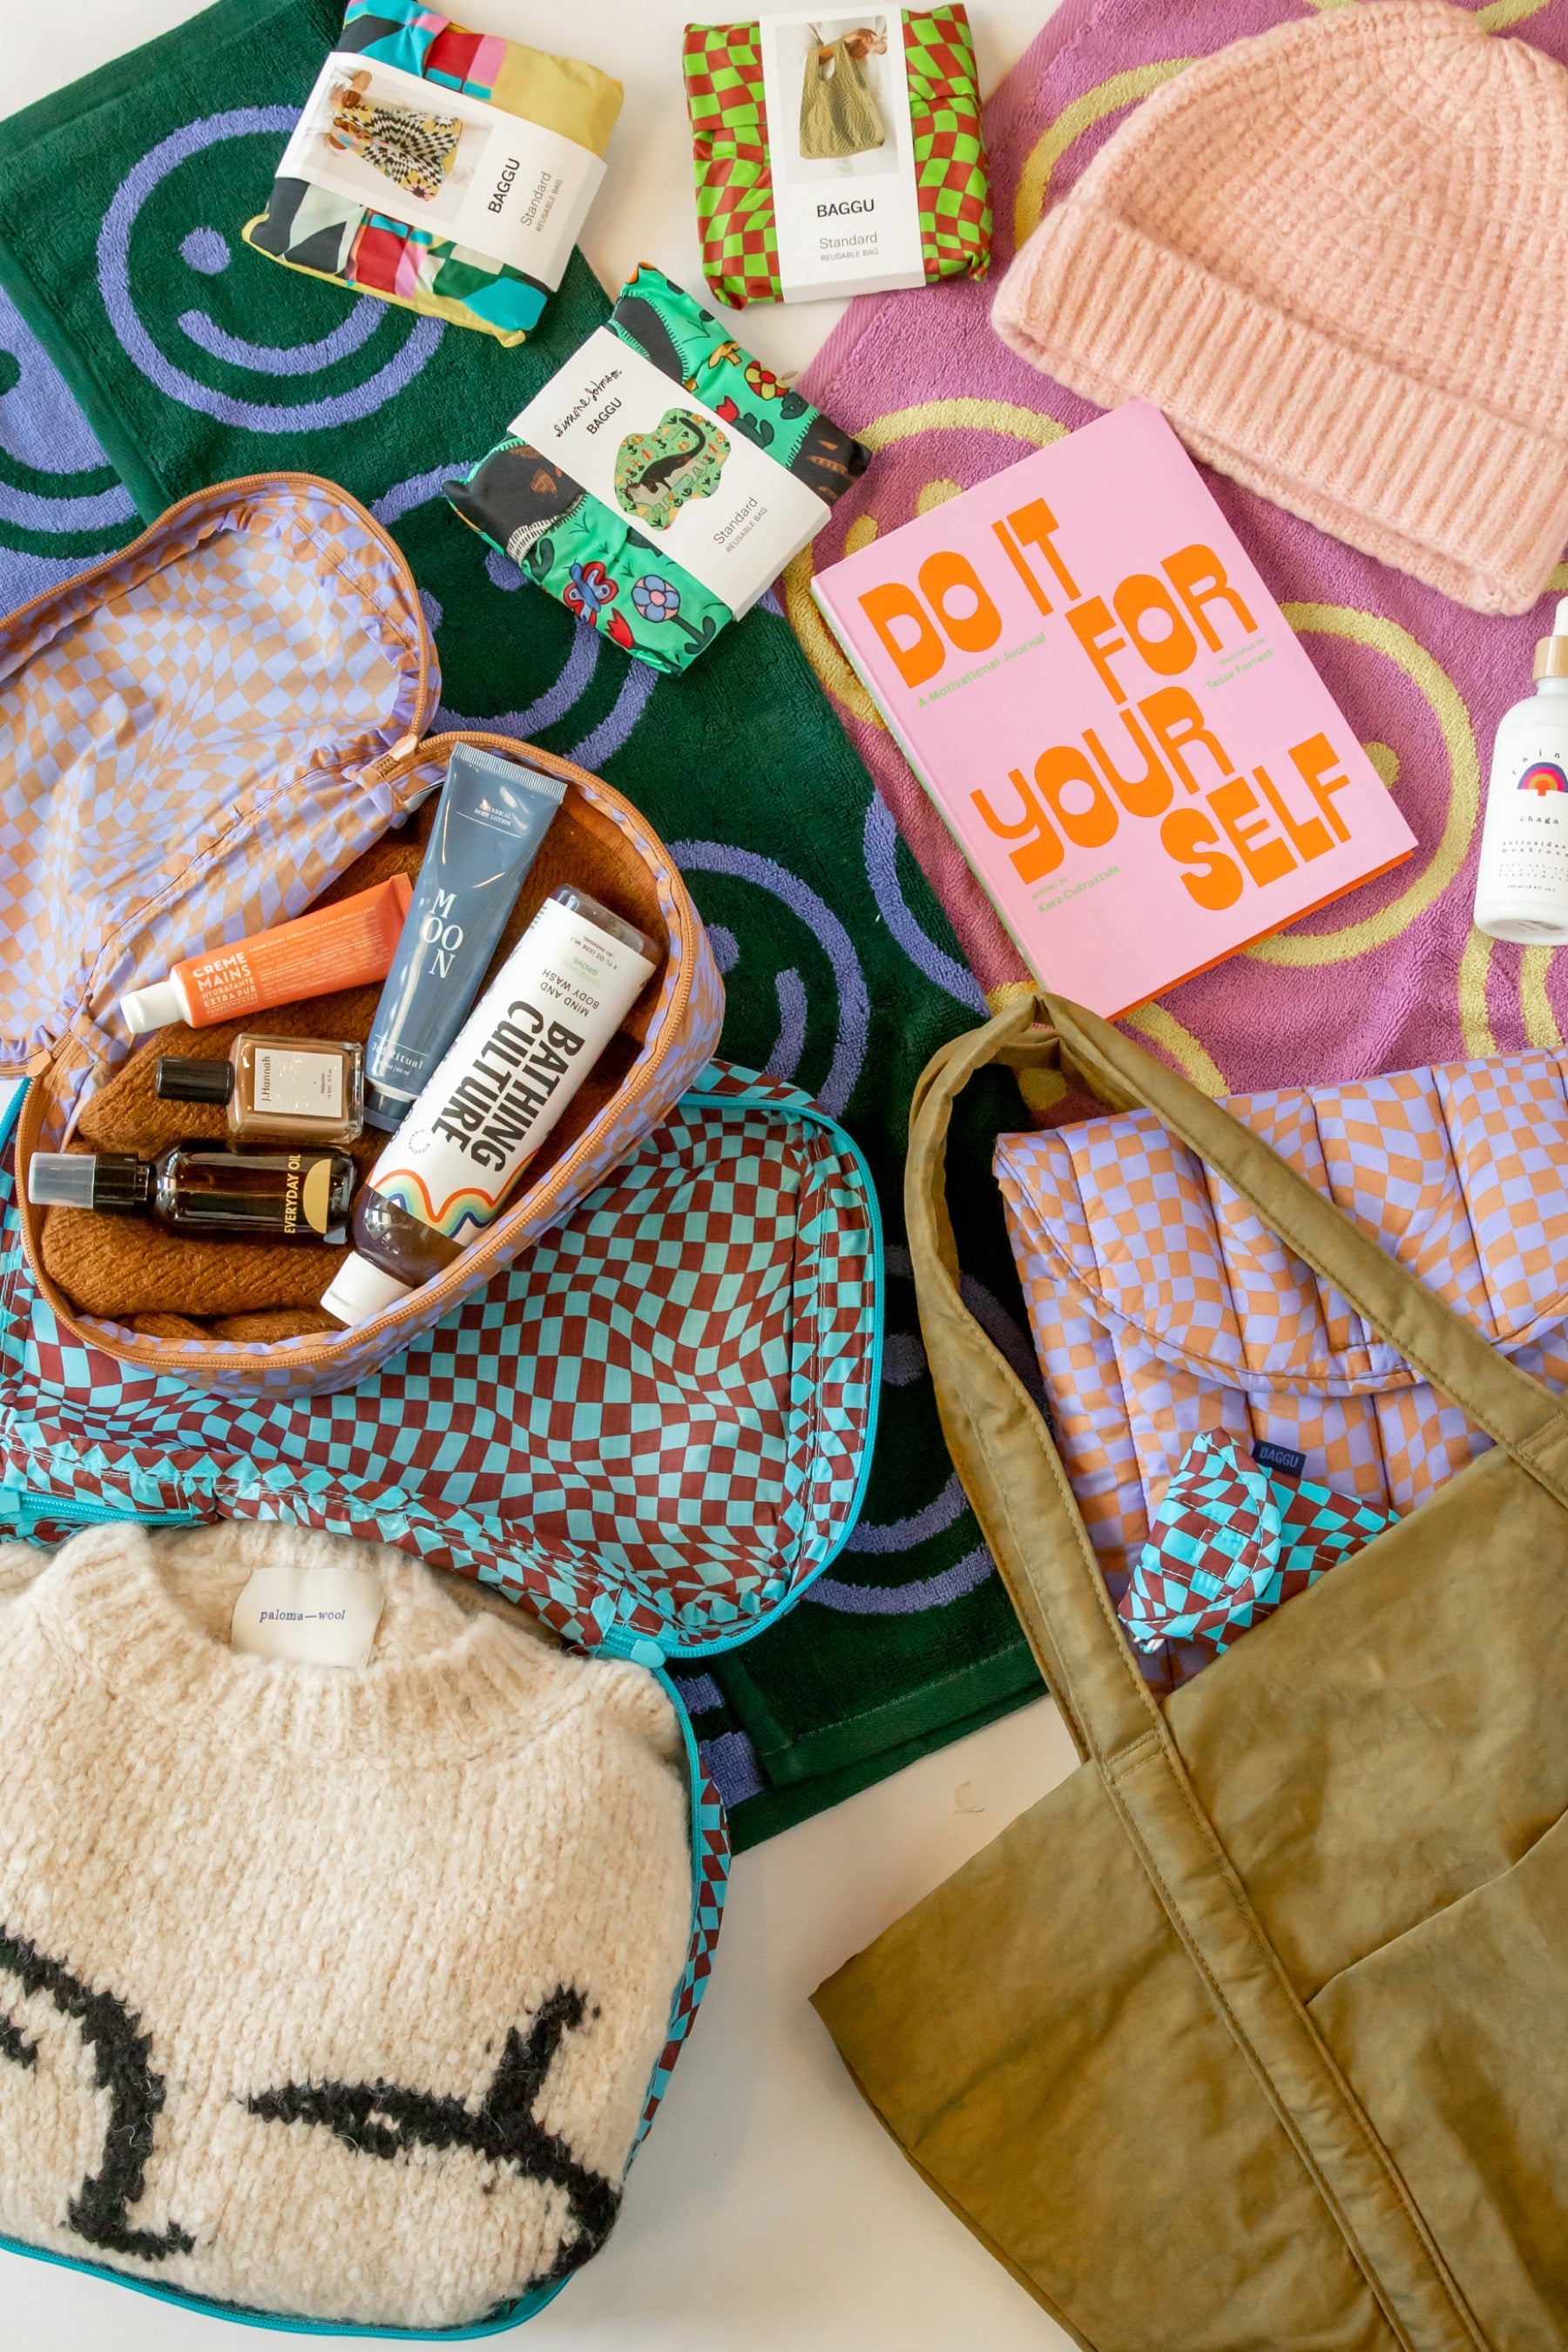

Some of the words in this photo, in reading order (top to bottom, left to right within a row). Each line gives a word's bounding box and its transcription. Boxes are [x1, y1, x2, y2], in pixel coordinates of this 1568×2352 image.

[488, 158, 521, 213] BAGGU
[520, 171, 551, 226] Standard
[536, 194, 556, 232] REUSABLE
[551, 179, 563, 195] BAG
[817, 199, 875, 218] BAGGU
[820, 232, 878, 249] Standard
[821, 251, 861, 262] REUSABLE
[862, 248, 879, 257] BAG
[585, 397, 623, 435] BAGGU
[713, 496, 759, 544] Standard
[725, 521, 756, 553] REUSABLE
[754, 507, 768, 522] BAG
[858, 551, 1003, 688] DO
[991, 497, 1081, 616] IT
[1065, 544, 1258, 705] FOR
[918, 696, 929, 709] A
[928, 657, 1002, 702] Motivational
[1004, 632, 1046, 663] Journal
[1160, 733, 1351, 911] SELF
[1519, 814, 1559, 825] chaga
[192, 951, 247, 978] CREME
[196, 964, 252, 992] MAINS
[201, 977, 255, 1000] HYDRATANTE
[540, 982, 563, 999] AND
[542, 968, 571, 992] WASH
[203, 992, 236, 1008] EXTRA
[237, 985, 257, 997] PUR
[564, 997, 591, 1017] MIND
[571, 989, 601, 1010] BODY
[390, 1049, 424, 1070] Ritual
[430, 1000, 545, 1153] CULTURE
[470, 1020, 587, 1173] BATHING
[287, 1154, 301, 1171] OIL
[284, 1173, 300, 1233] EVERYDAY
[1260, 1447, 1300, 1469] BAGGU
